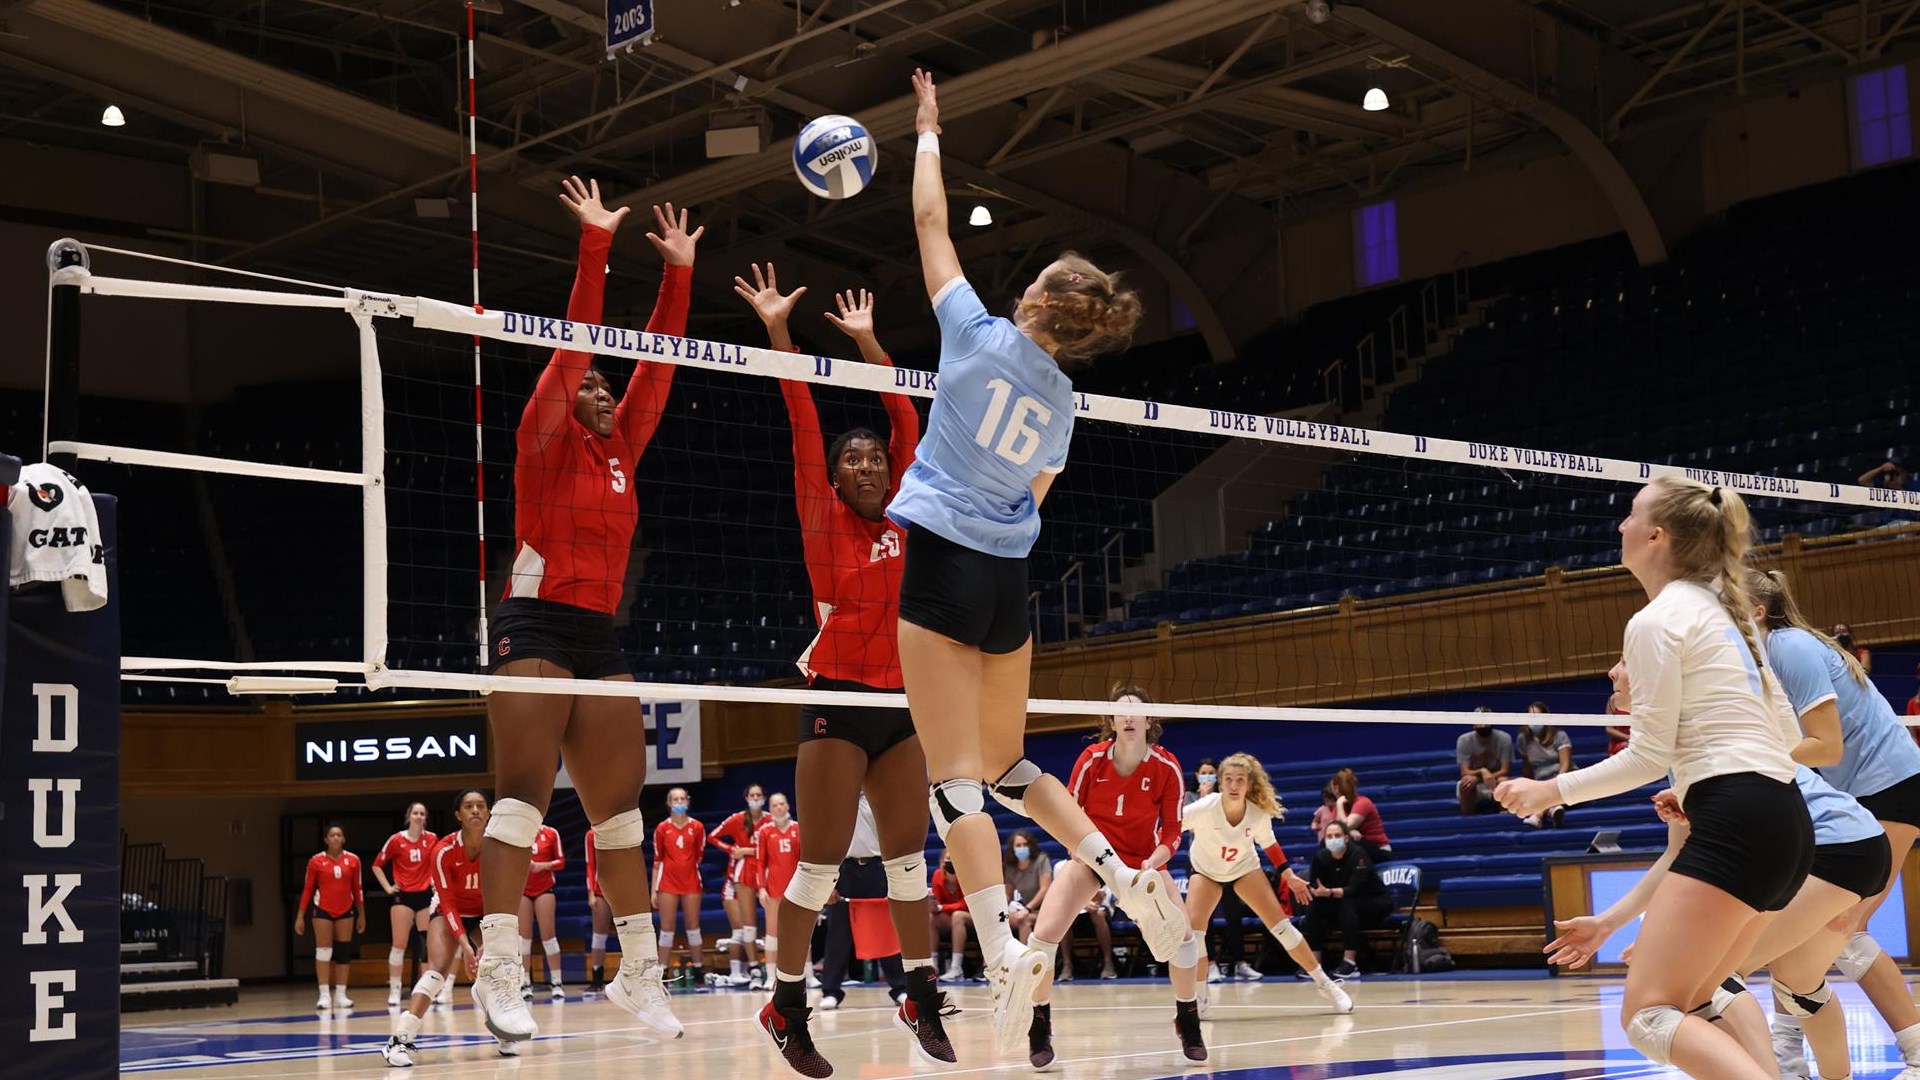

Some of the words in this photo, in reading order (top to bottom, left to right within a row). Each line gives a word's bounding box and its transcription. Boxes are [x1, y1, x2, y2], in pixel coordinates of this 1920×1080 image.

[614, 5, 645, 35] 2003
[819, 140, 862, 166] molten
[503, 312, 574, 342] DUKE
[586, 325, 747, 366] VOLLEYBALL
[894, 368, 938, 391] DUK
[975, 378, 1052, 466] 16
[1209, 410, 1257, 432] DUKE
[1264, 418, 1370, 446] VOLLEYBALL
[1469, 443, 1508, 462] DUKE
[1514, 448, 1603, 473] VOLLEYBALL
[608, 457, 627, 494] 5
[1685, 468, 1719, 486] DUKE
[1723, 472, 1799, 494] VOLLEYBALL
[1869, 488, 1898, 503] DUKE
[306, 734, 477, 764] NISSAN
[1115, 794, 1125, 816] 1
[779, 838, 792, 853] 15
[1221, 846, 1239, 862] 12
[22, 682, 84, 1042] DUKE
[464, 873, 479, 890] 11
[1382, 868, 1416, 886] DUKE
